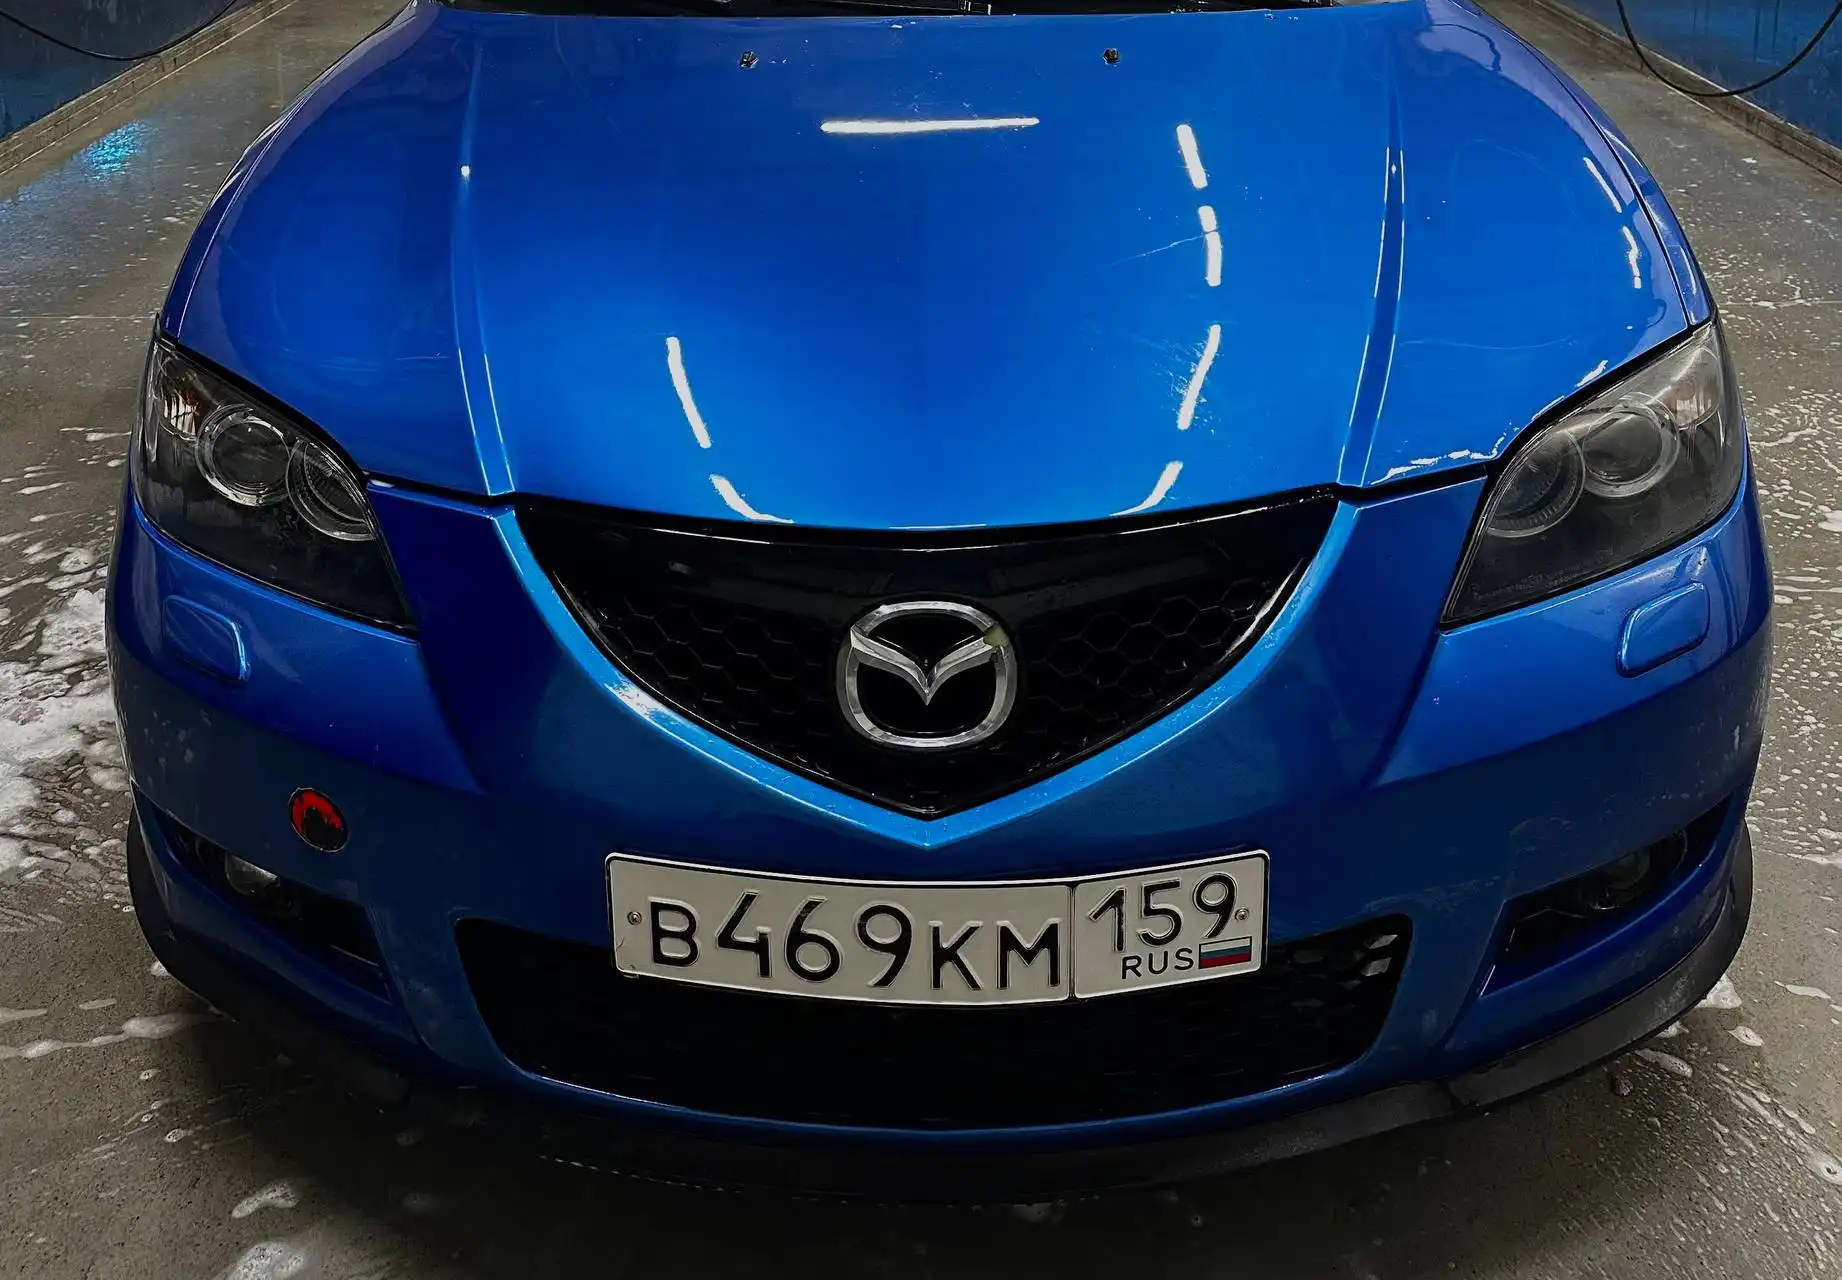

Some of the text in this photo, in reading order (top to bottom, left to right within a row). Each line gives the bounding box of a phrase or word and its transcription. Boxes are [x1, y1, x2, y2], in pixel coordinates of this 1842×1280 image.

[649, 873, 1237, 990] В469КМ 159
[1121, 947, 1194, 979] RUS
